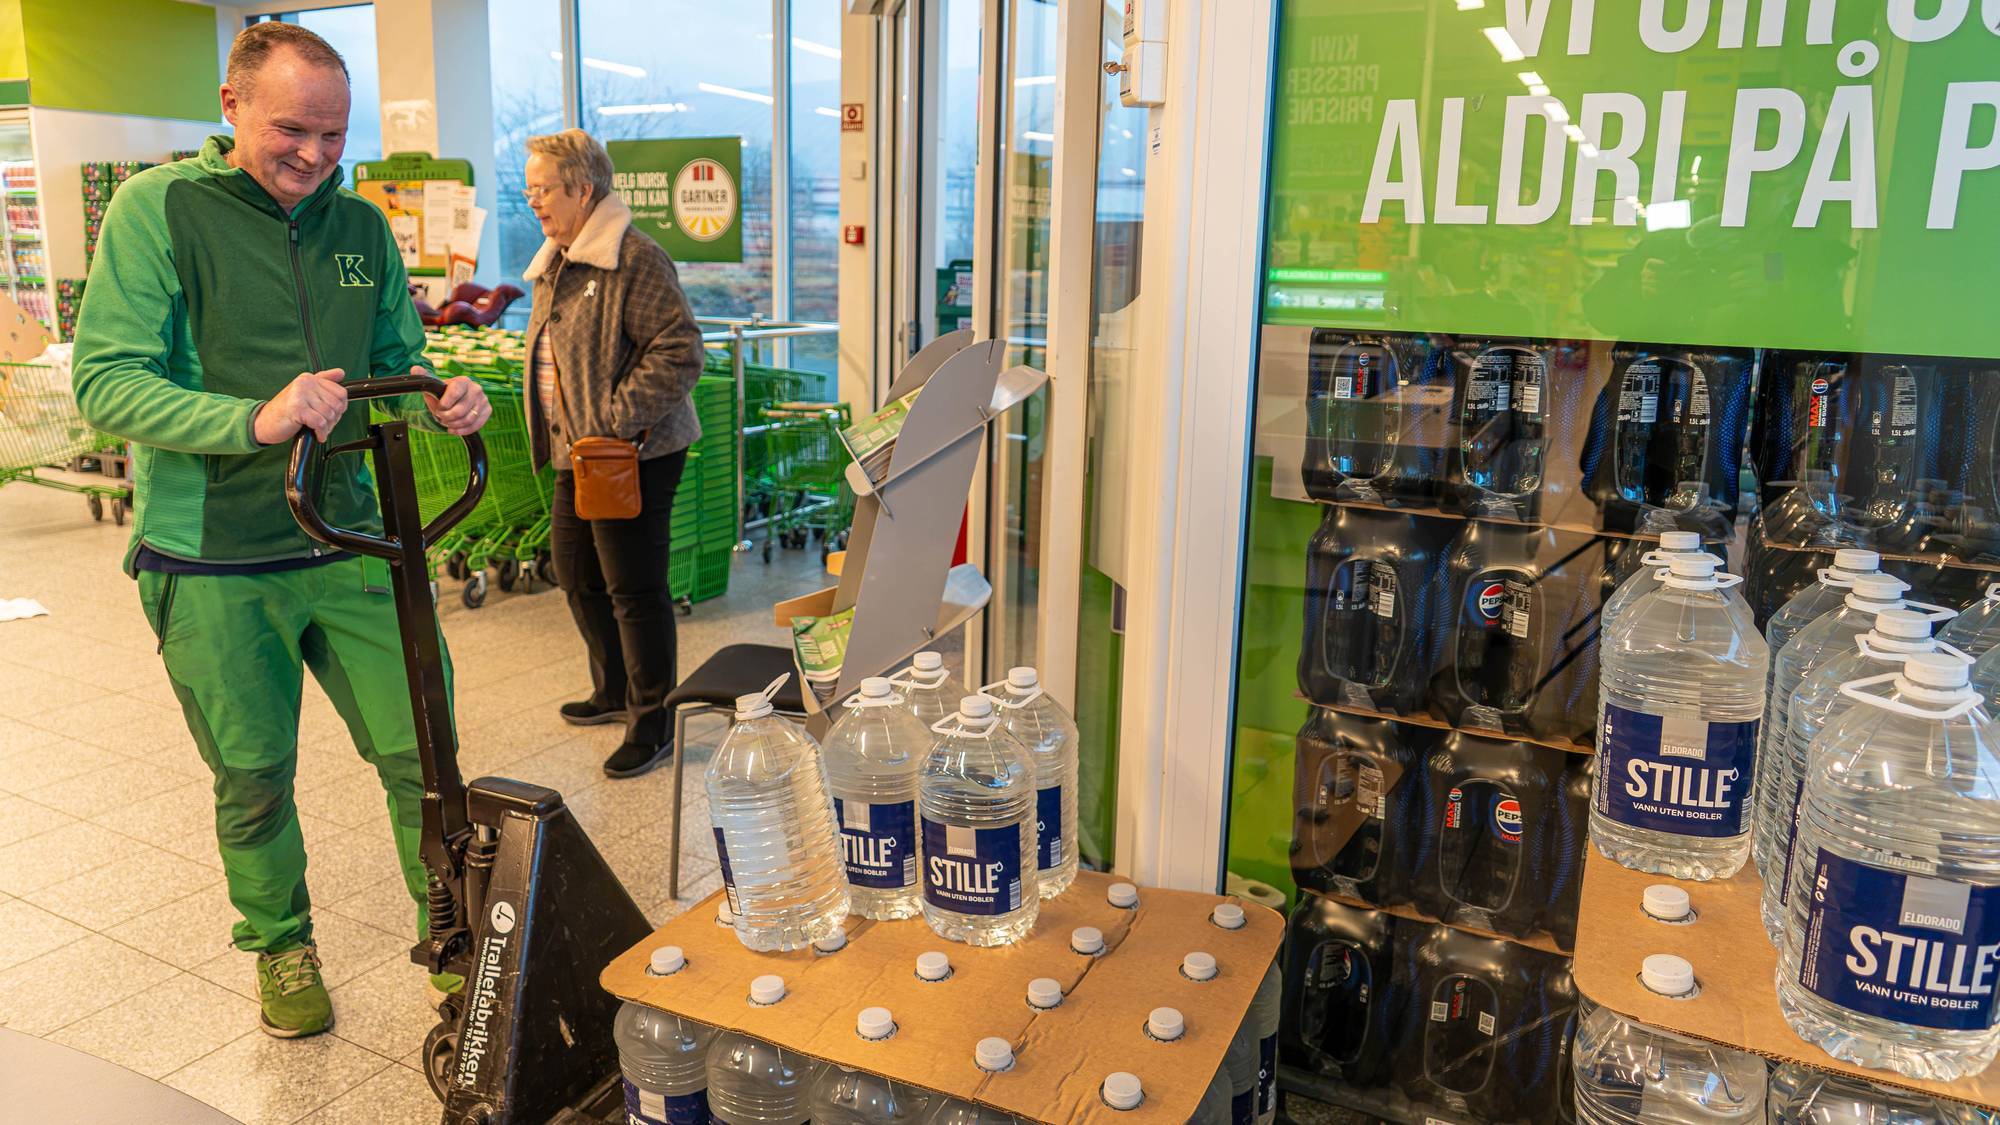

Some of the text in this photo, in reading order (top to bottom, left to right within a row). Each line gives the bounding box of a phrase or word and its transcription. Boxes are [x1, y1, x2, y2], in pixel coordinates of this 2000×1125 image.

[1361, 39, 2000, 230] ALDRI PÅ P
[612, 171, 668, 189] VELG NORSK
[633, 189, 647, 207] DU
[647, 189, 669, 207] KAN
[681, 188, 728, 203] GARTNER
[334, 254, 375, 287] K
[1809, 395, 1820, 427] MAX
[1663, 744, 1703, 758] ELDORADO
[1625, 758, 1733, 808] STILLE
[1446, 801, 1455, 828] MAX
[1632, 801, 1722, 821] VANN UTEN BOBLER
[863, 868, 888, 878] BOBLER
[930, 855, 999, 894] STILLE
[951, 893, 968, 902] UTEN
[968, 895, 994, 904] BOBLER
[1903, 911, 1960, 931] ELDORADO
[1845, 925, 1994, 995] STILLE
[468, 936, 490, 1022] www.trallefabrikken.no
[1855, 980, 1979, 1010] VANN UTEN BOBLER
[465, 936, 507, 1086] Trallefabrikken
